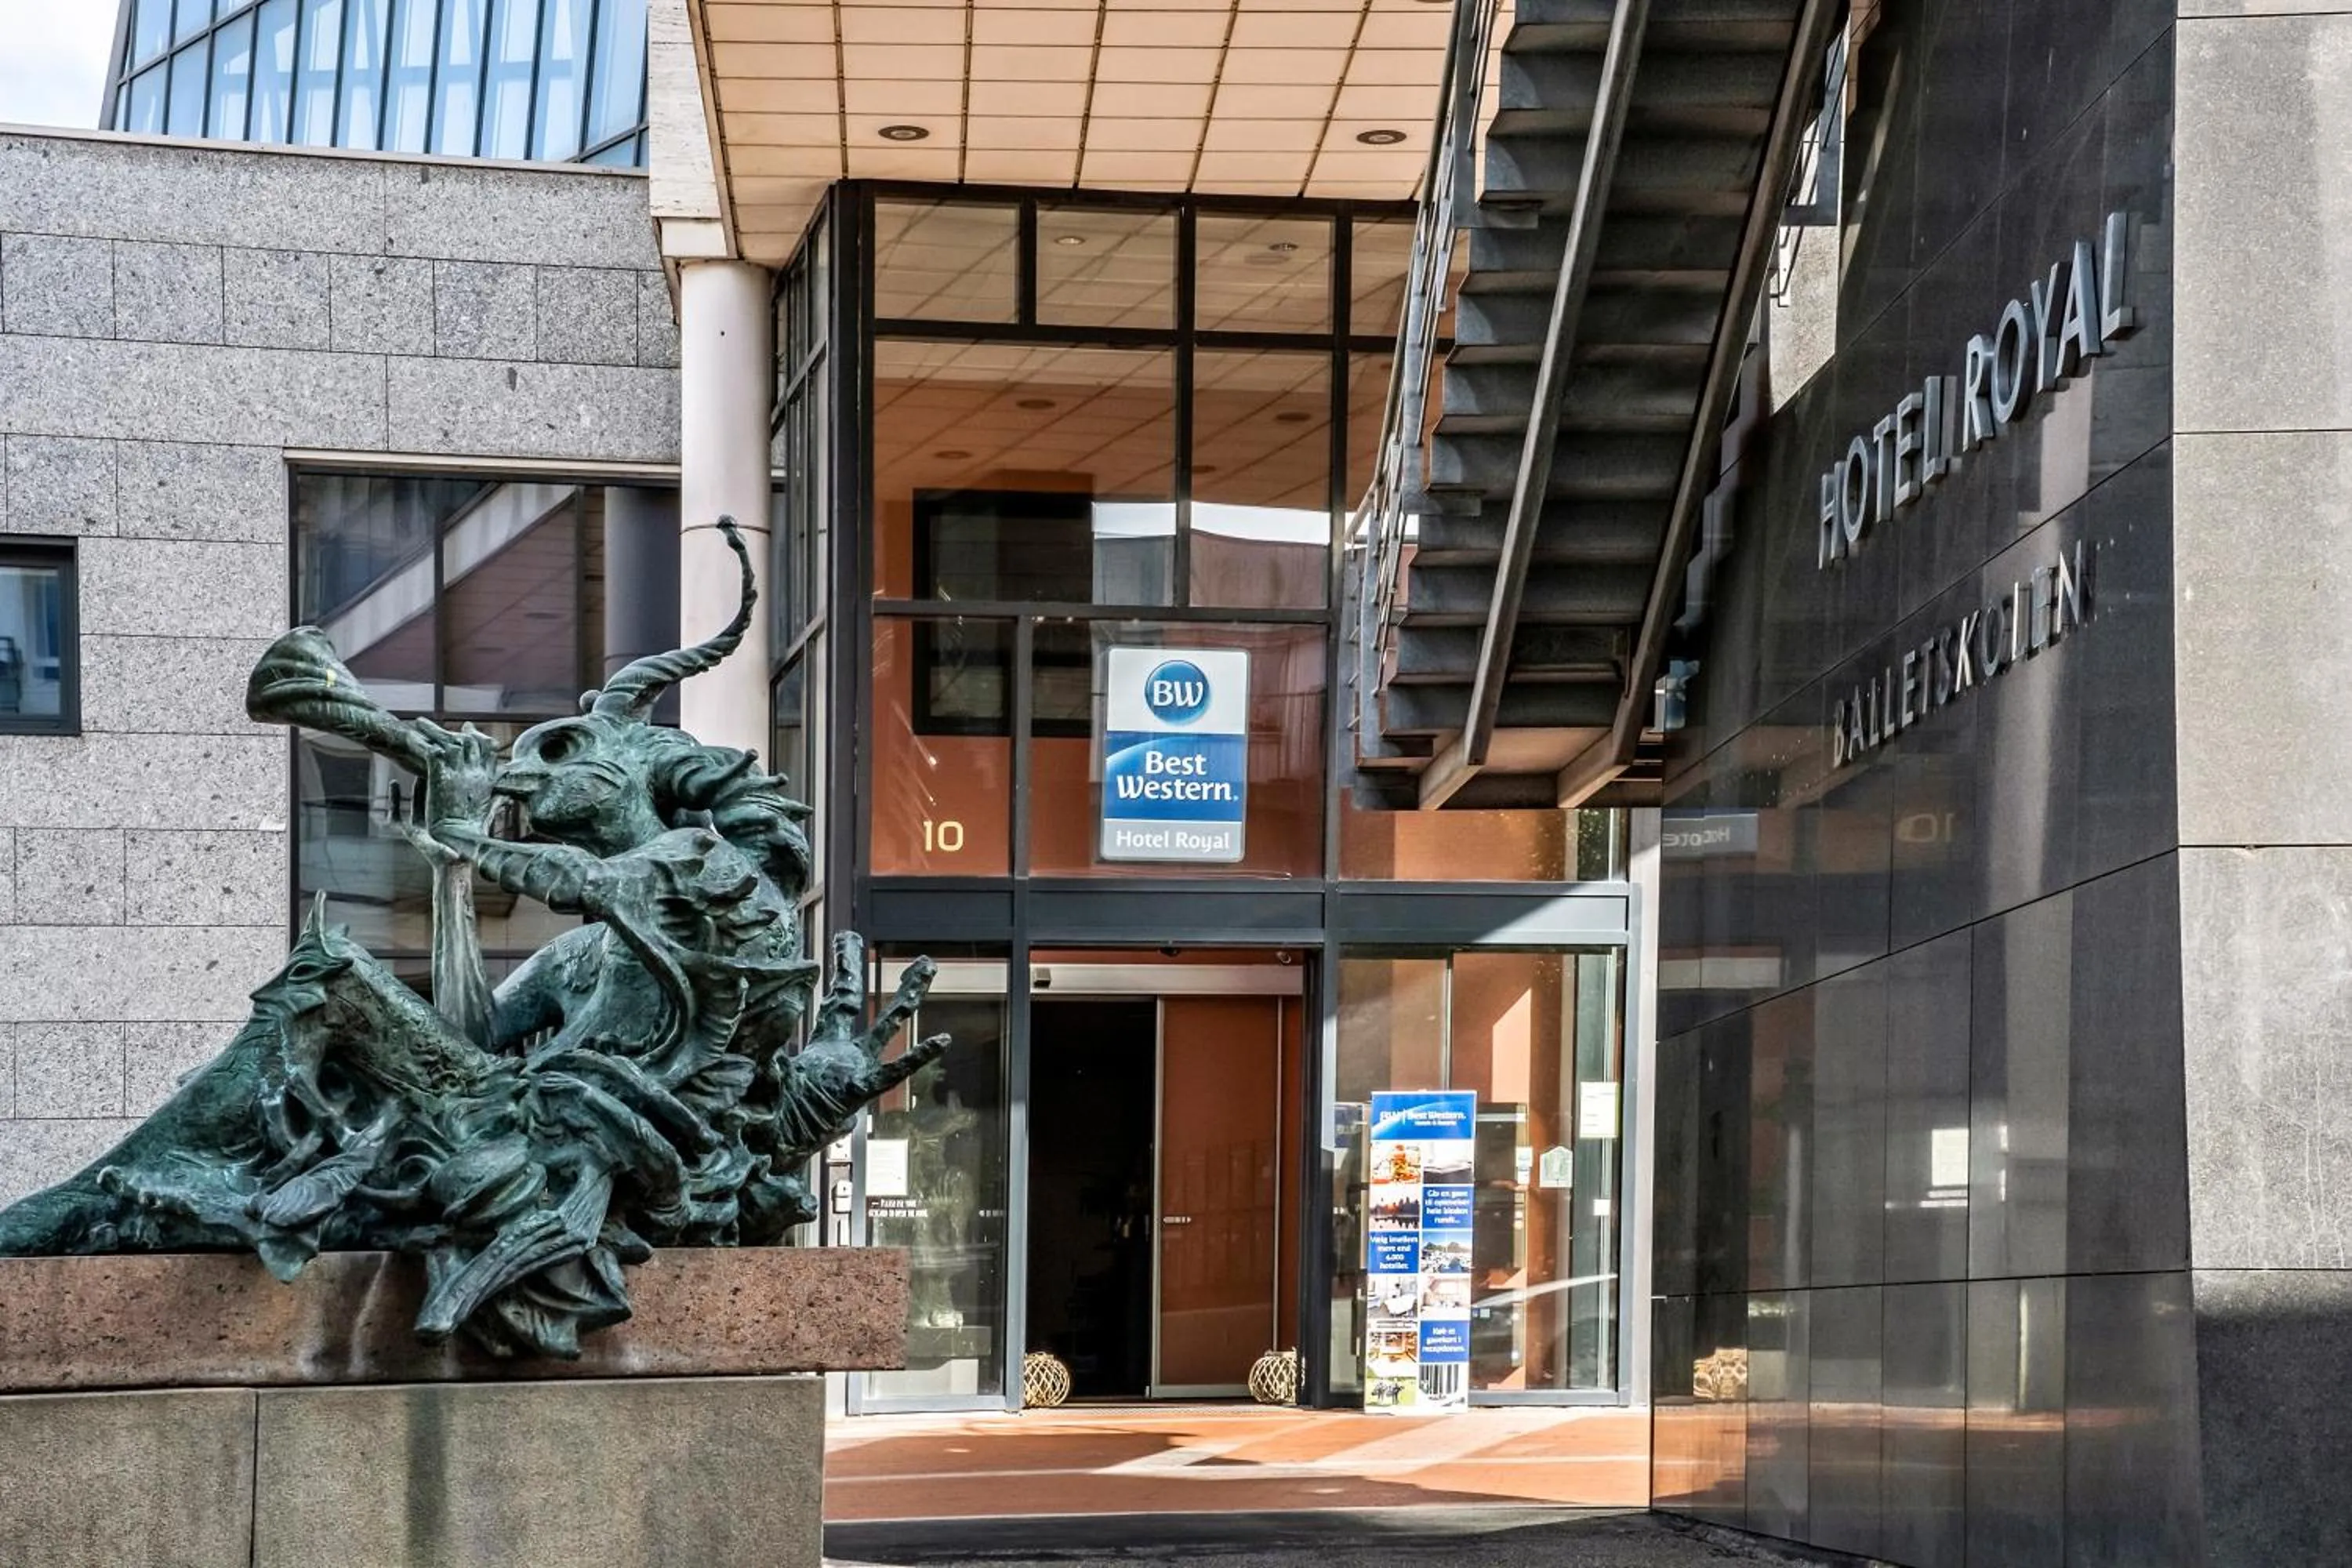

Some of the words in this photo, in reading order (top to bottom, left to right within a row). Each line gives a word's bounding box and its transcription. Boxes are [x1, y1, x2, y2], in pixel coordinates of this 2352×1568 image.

[1817, 376, 1952, 570] HOTEL
[1962, 211, 2133, 452] ROYAL
[1833, 539, 2083, 768] BALLETSKOLEN
[1152, 680, 1203, 707] BW
[1145, 750, 1207, 775] Best
[923, 820, 964, 852] 10
[1116, 830, 1169, 849] Hotel
[1175, 831, 1230, 854] Royal
